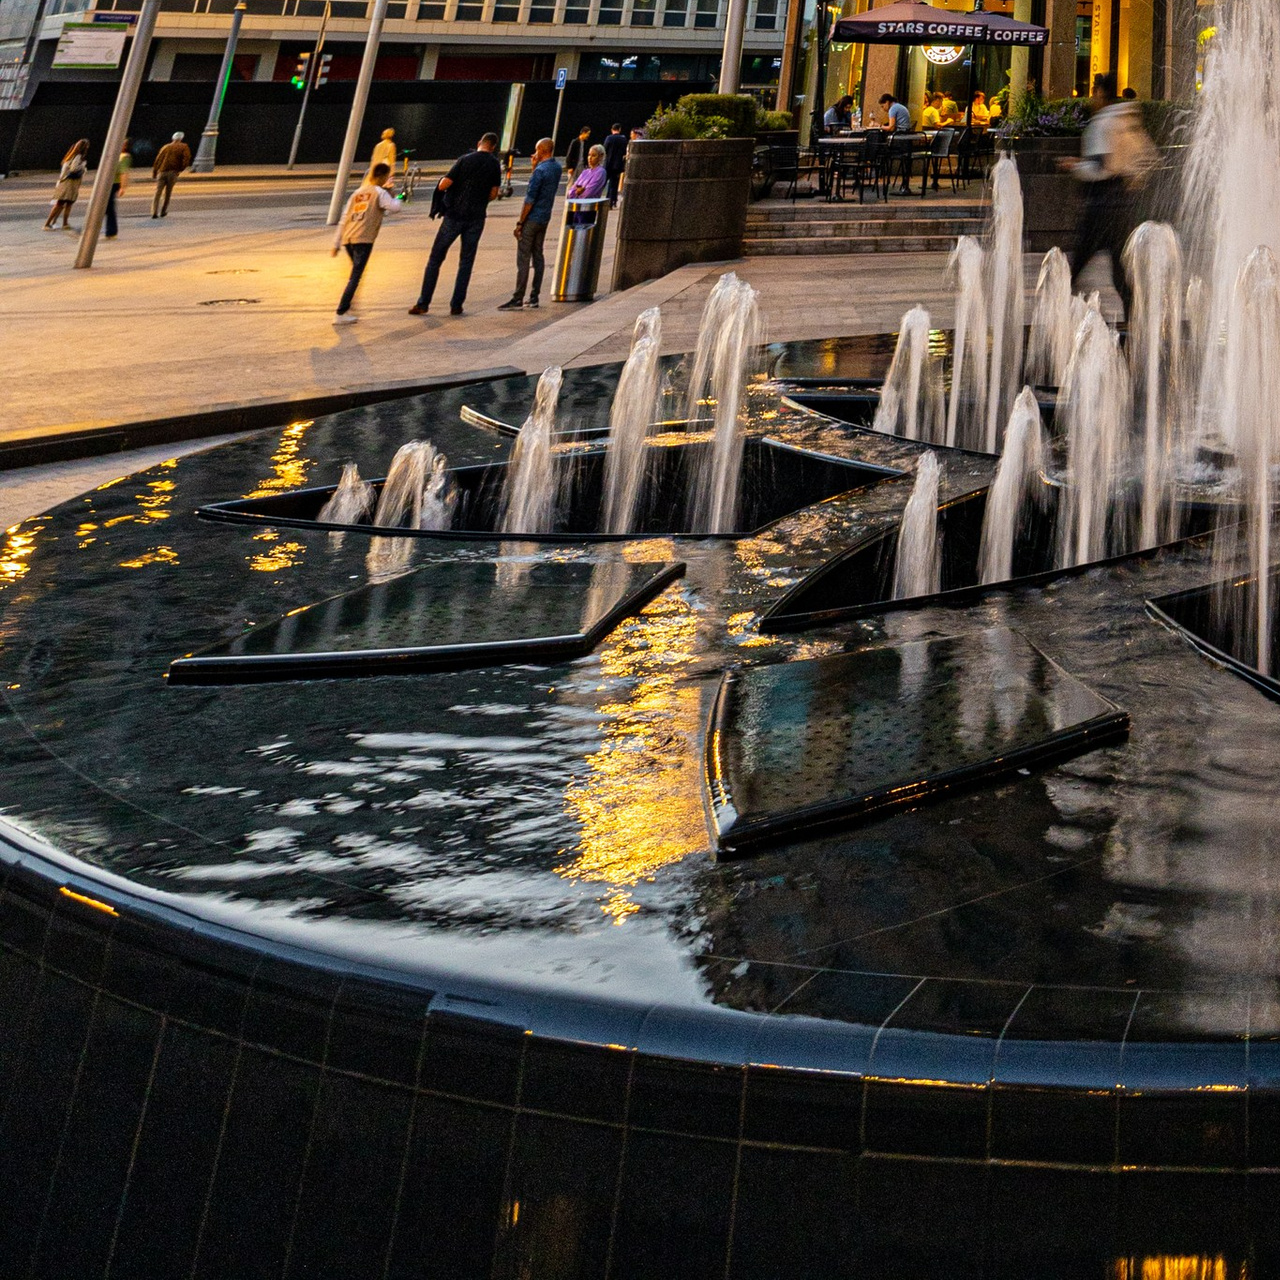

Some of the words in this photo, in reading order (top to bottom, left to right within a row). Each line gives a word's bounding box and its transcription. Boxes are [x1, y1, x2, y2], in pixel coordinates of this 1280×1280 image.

[877, 22, 924, 35] STARS
[927, 23, 984, 37] COFFEE
[994, 30, 1044, 42] COFFEE
[926, 48, 958, 62] COFFEE
